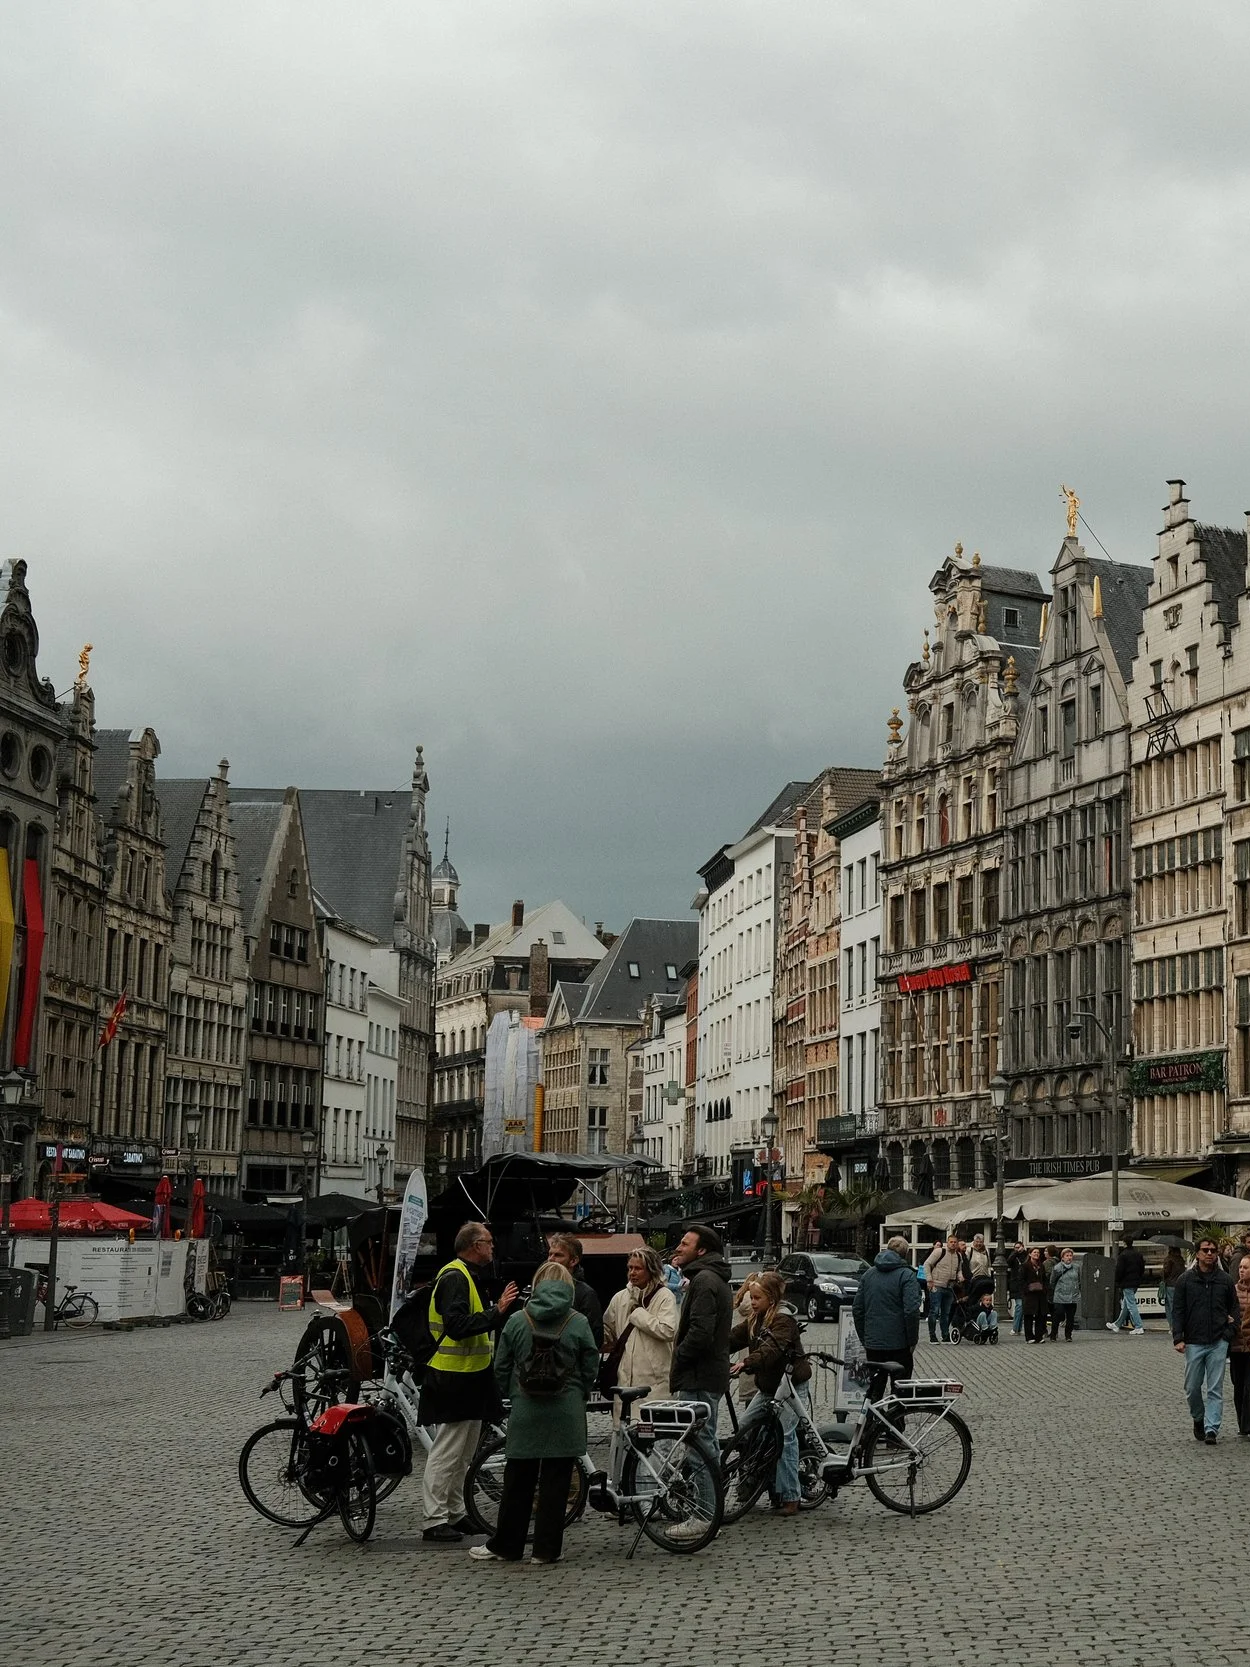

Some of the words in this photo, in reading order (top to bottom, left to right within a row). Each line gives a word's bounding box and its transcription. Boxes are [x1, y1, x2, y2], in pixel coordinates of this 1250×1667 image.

[1150, 1066, 1167, 1079] BAR
[1168, 1063, 1203, 1078] PATRON
[1029, 1162, 1043, 1174] THE
[1043, 1161, 1062, 1174] IRISH
[1063, 1160, 1085, 1173] TIMES
[1085, 1160, 1100, 1172] PUB
